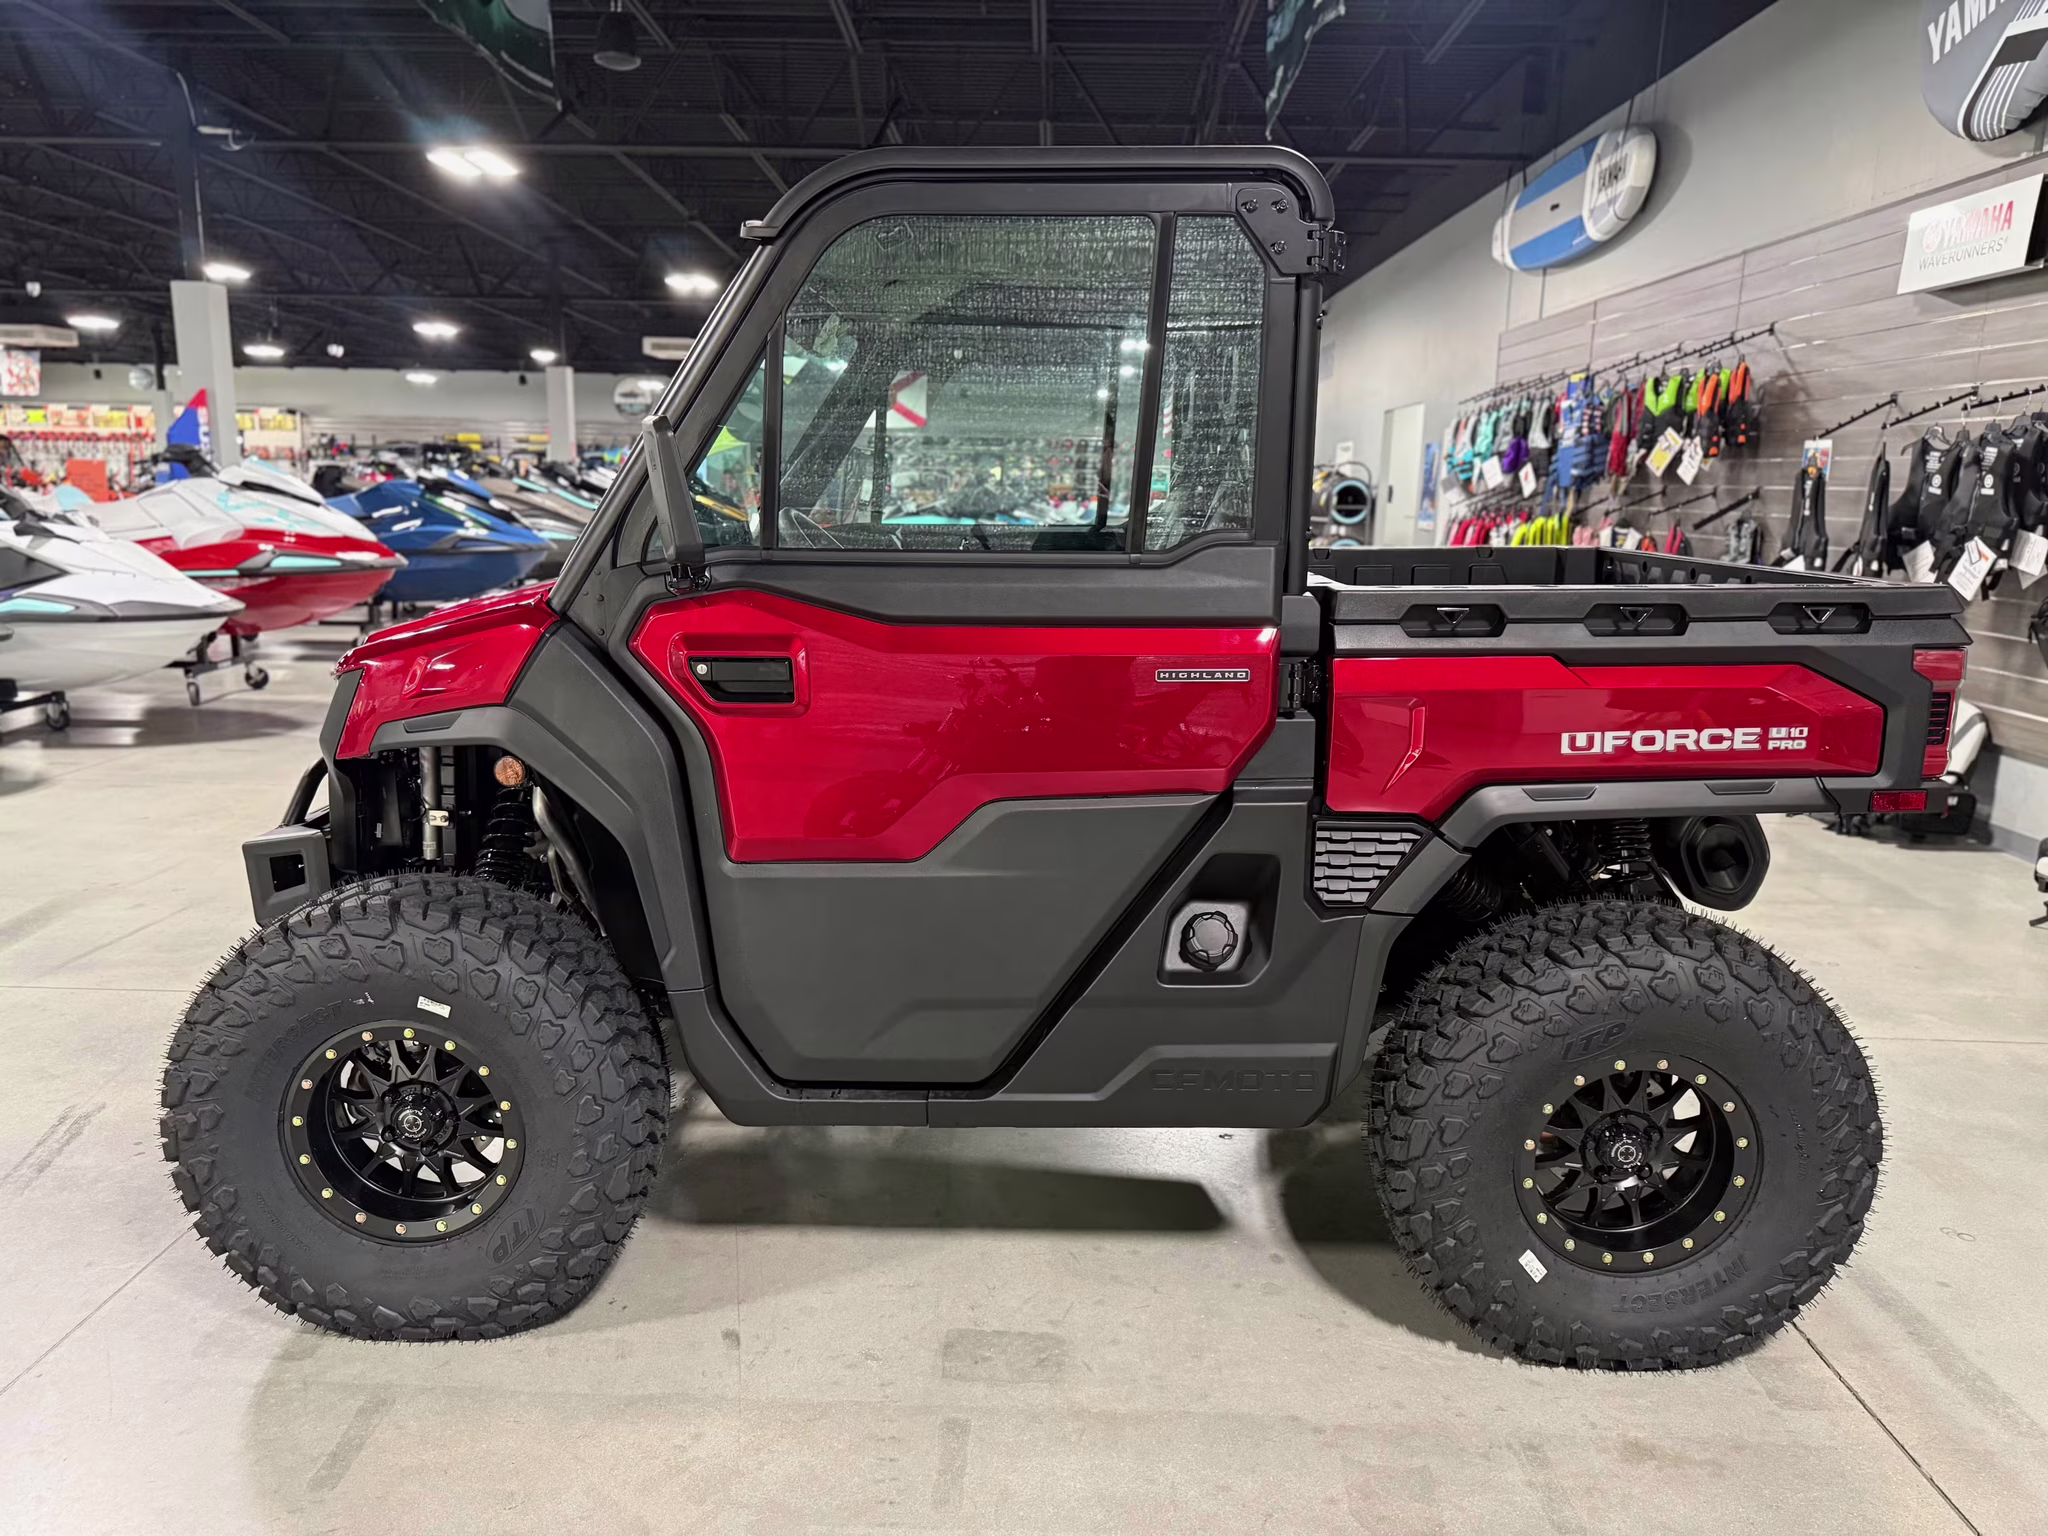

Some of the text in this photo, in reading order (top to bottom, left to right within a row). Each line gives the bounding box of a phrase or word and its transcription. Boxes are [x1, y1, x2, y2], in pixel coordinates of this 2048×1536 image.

[1927, 0, 2005, 64] YAM
[1943, 200, 2014, 249] YAMAHA
[1560, 727, 1763, 755] UFORCE
[1767, 739, 1807, 750] PRO
[1152, 1069, 1319, 1092] CFMOTO
[1612, 1254, 1750, 1313] INTERSECT
